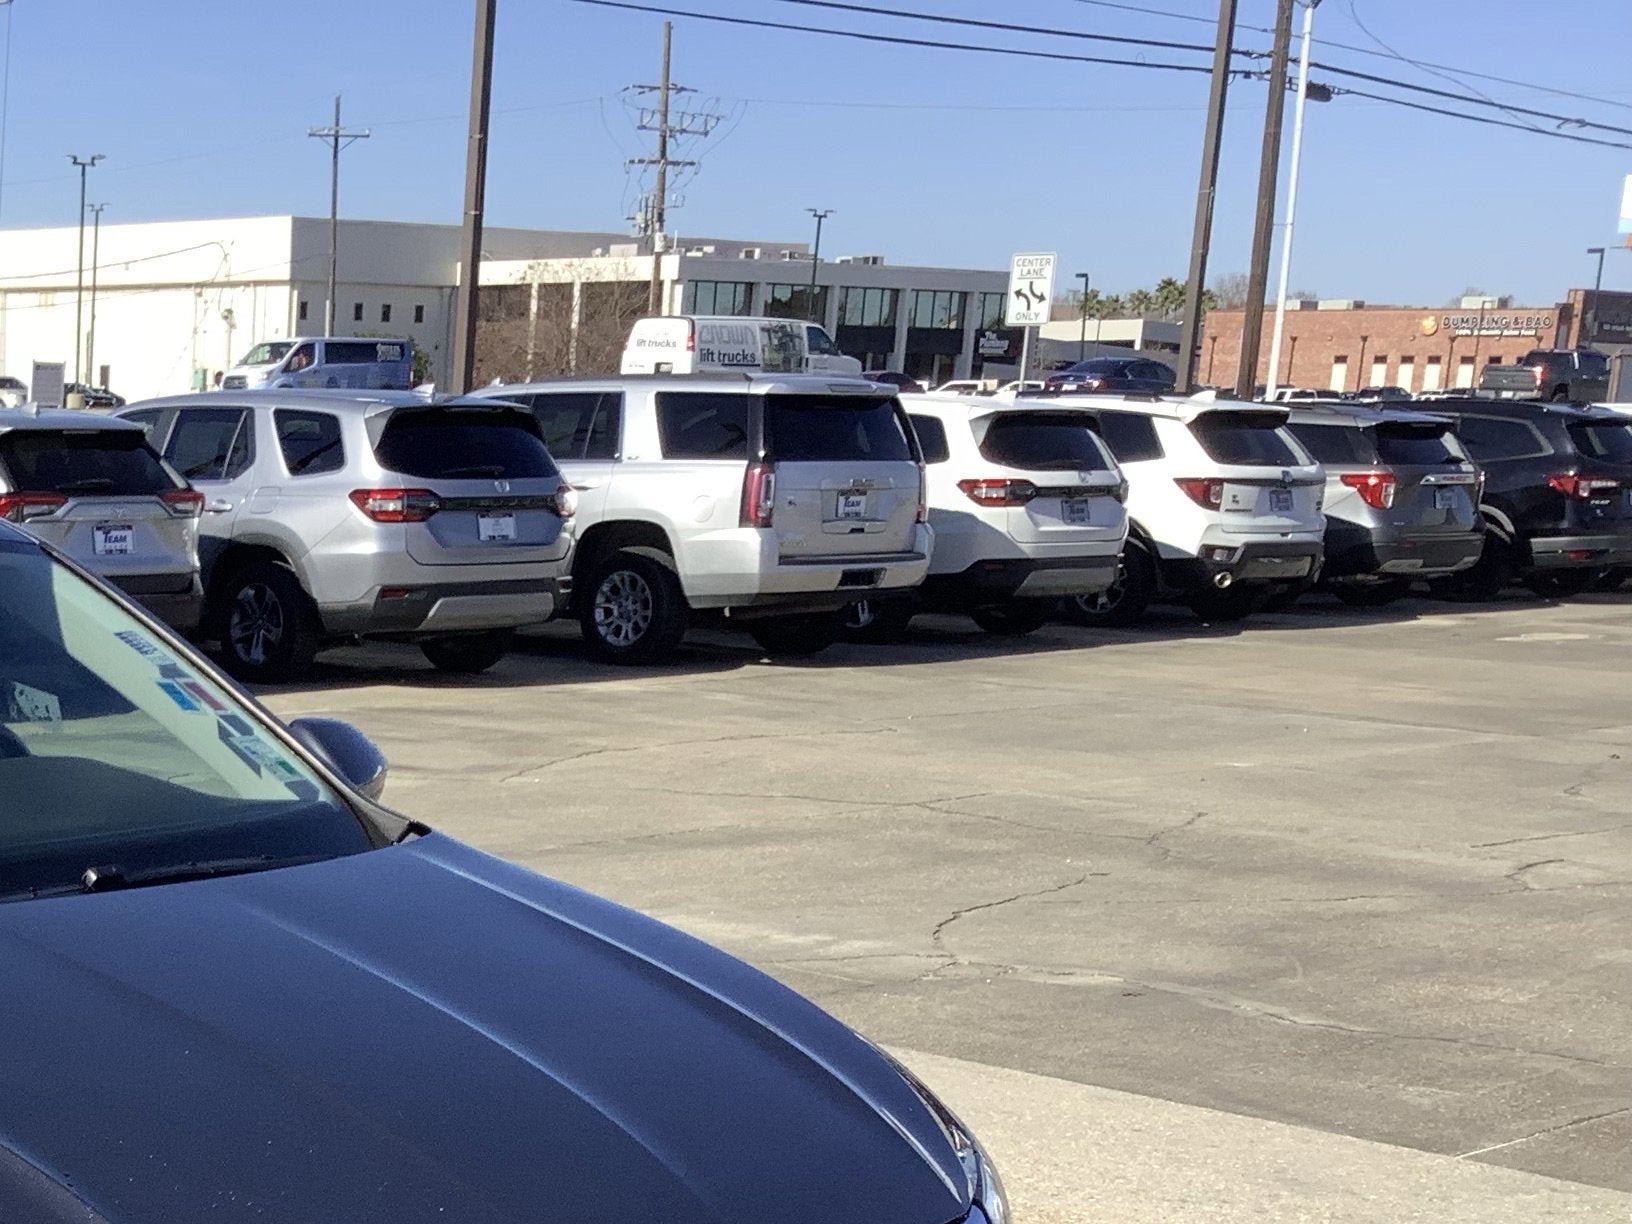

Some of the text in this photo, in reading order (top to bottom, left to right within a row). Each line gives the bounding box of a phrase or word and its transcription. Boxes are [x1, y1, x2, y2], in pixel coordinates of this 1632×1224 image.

[1016, 257, 1052, 268] CENTER
[1020, 268, 1045, 277] LANE
[1015, 312, 1040, 321] ONLY
[1525, 316, 1553, 329] BAO
[636, 338, 677, 348] lift trucks
[700, 348, 757, 363] lift trucks
[103, 529, 127, 543] TEAM
